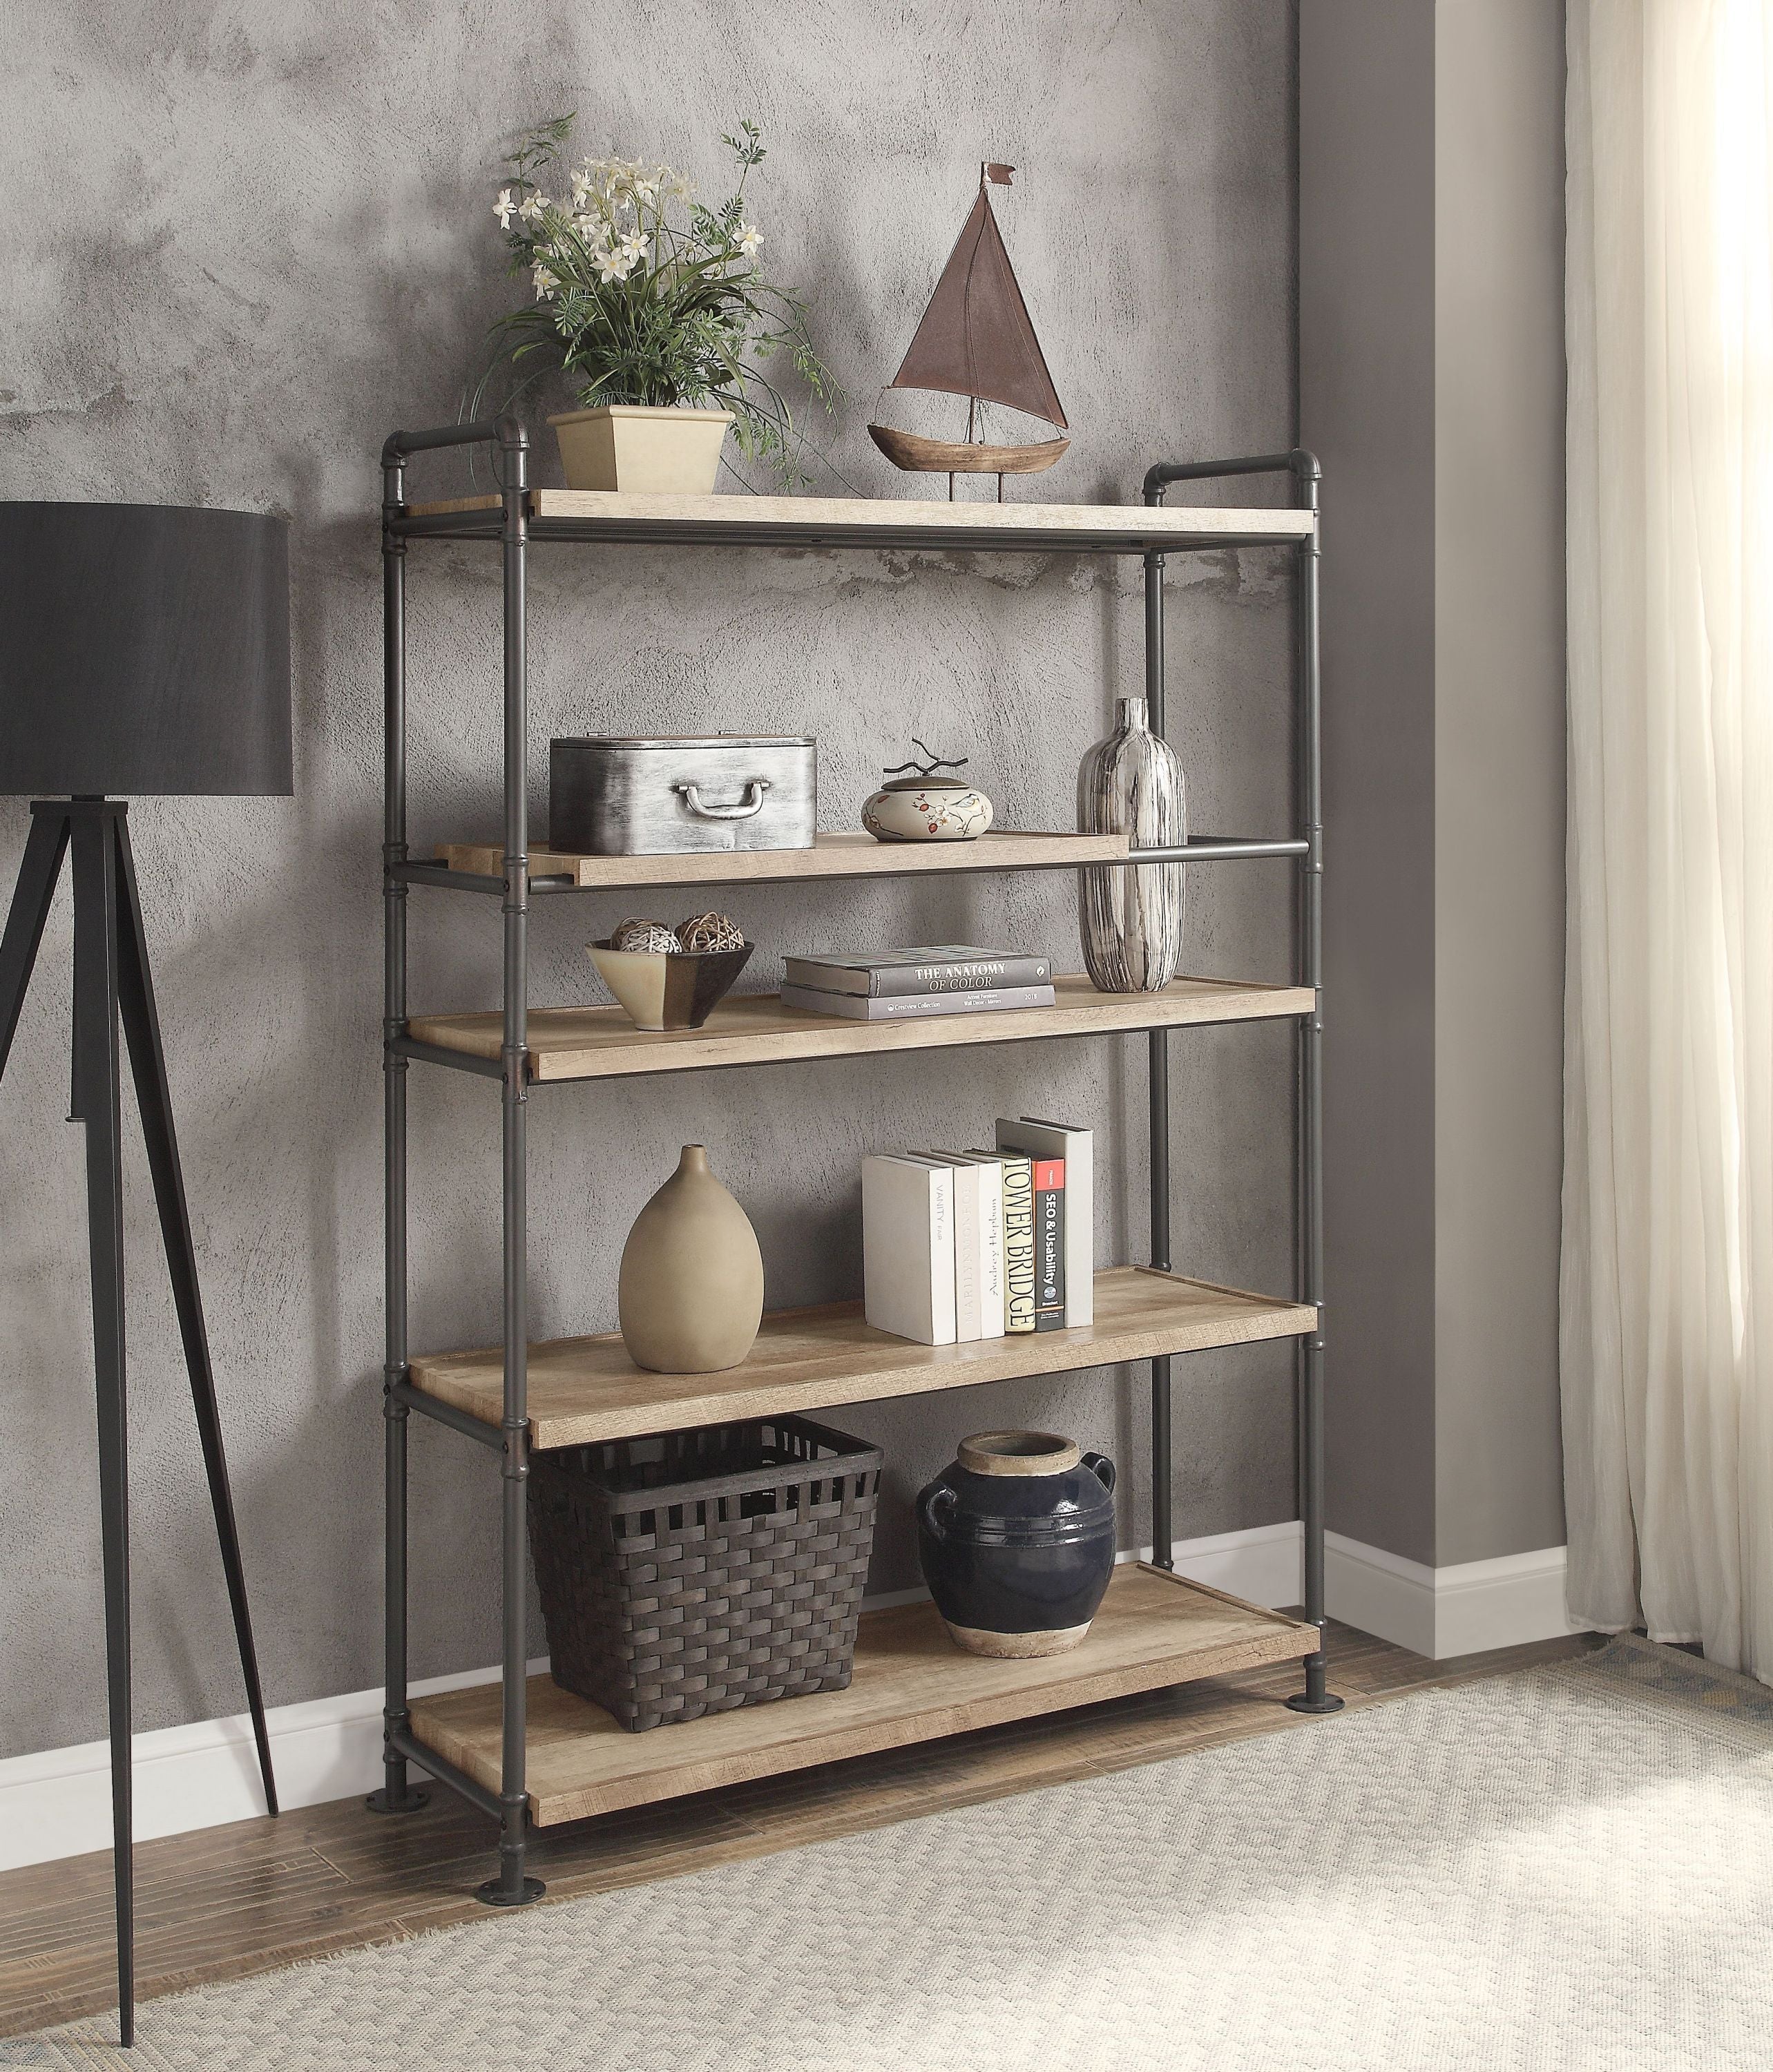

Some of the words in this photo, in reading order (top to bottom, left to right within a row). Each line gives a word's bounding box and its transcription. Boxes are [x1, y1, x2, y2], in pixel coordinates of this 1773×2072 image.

[914, 968, 941, 980] THE
[945, 963, 1006, 978] ANATOMY
[929, 979, 946, 991] OF
[950, 976, 993, 990] COLOR
[988, 1198, 999, 1246] Hepburn
[1004, 1158, 1032, 1240] TOWER
[1046, 1193, 1057, 1218] SEO
[1046, 1220, 1056, 1231] &
[988, 1250, 999, 1296] Audrey
[1042, 1231, 1057, 1285] Usability
[1007, 1243, 1035, 1326] BRIDGE
